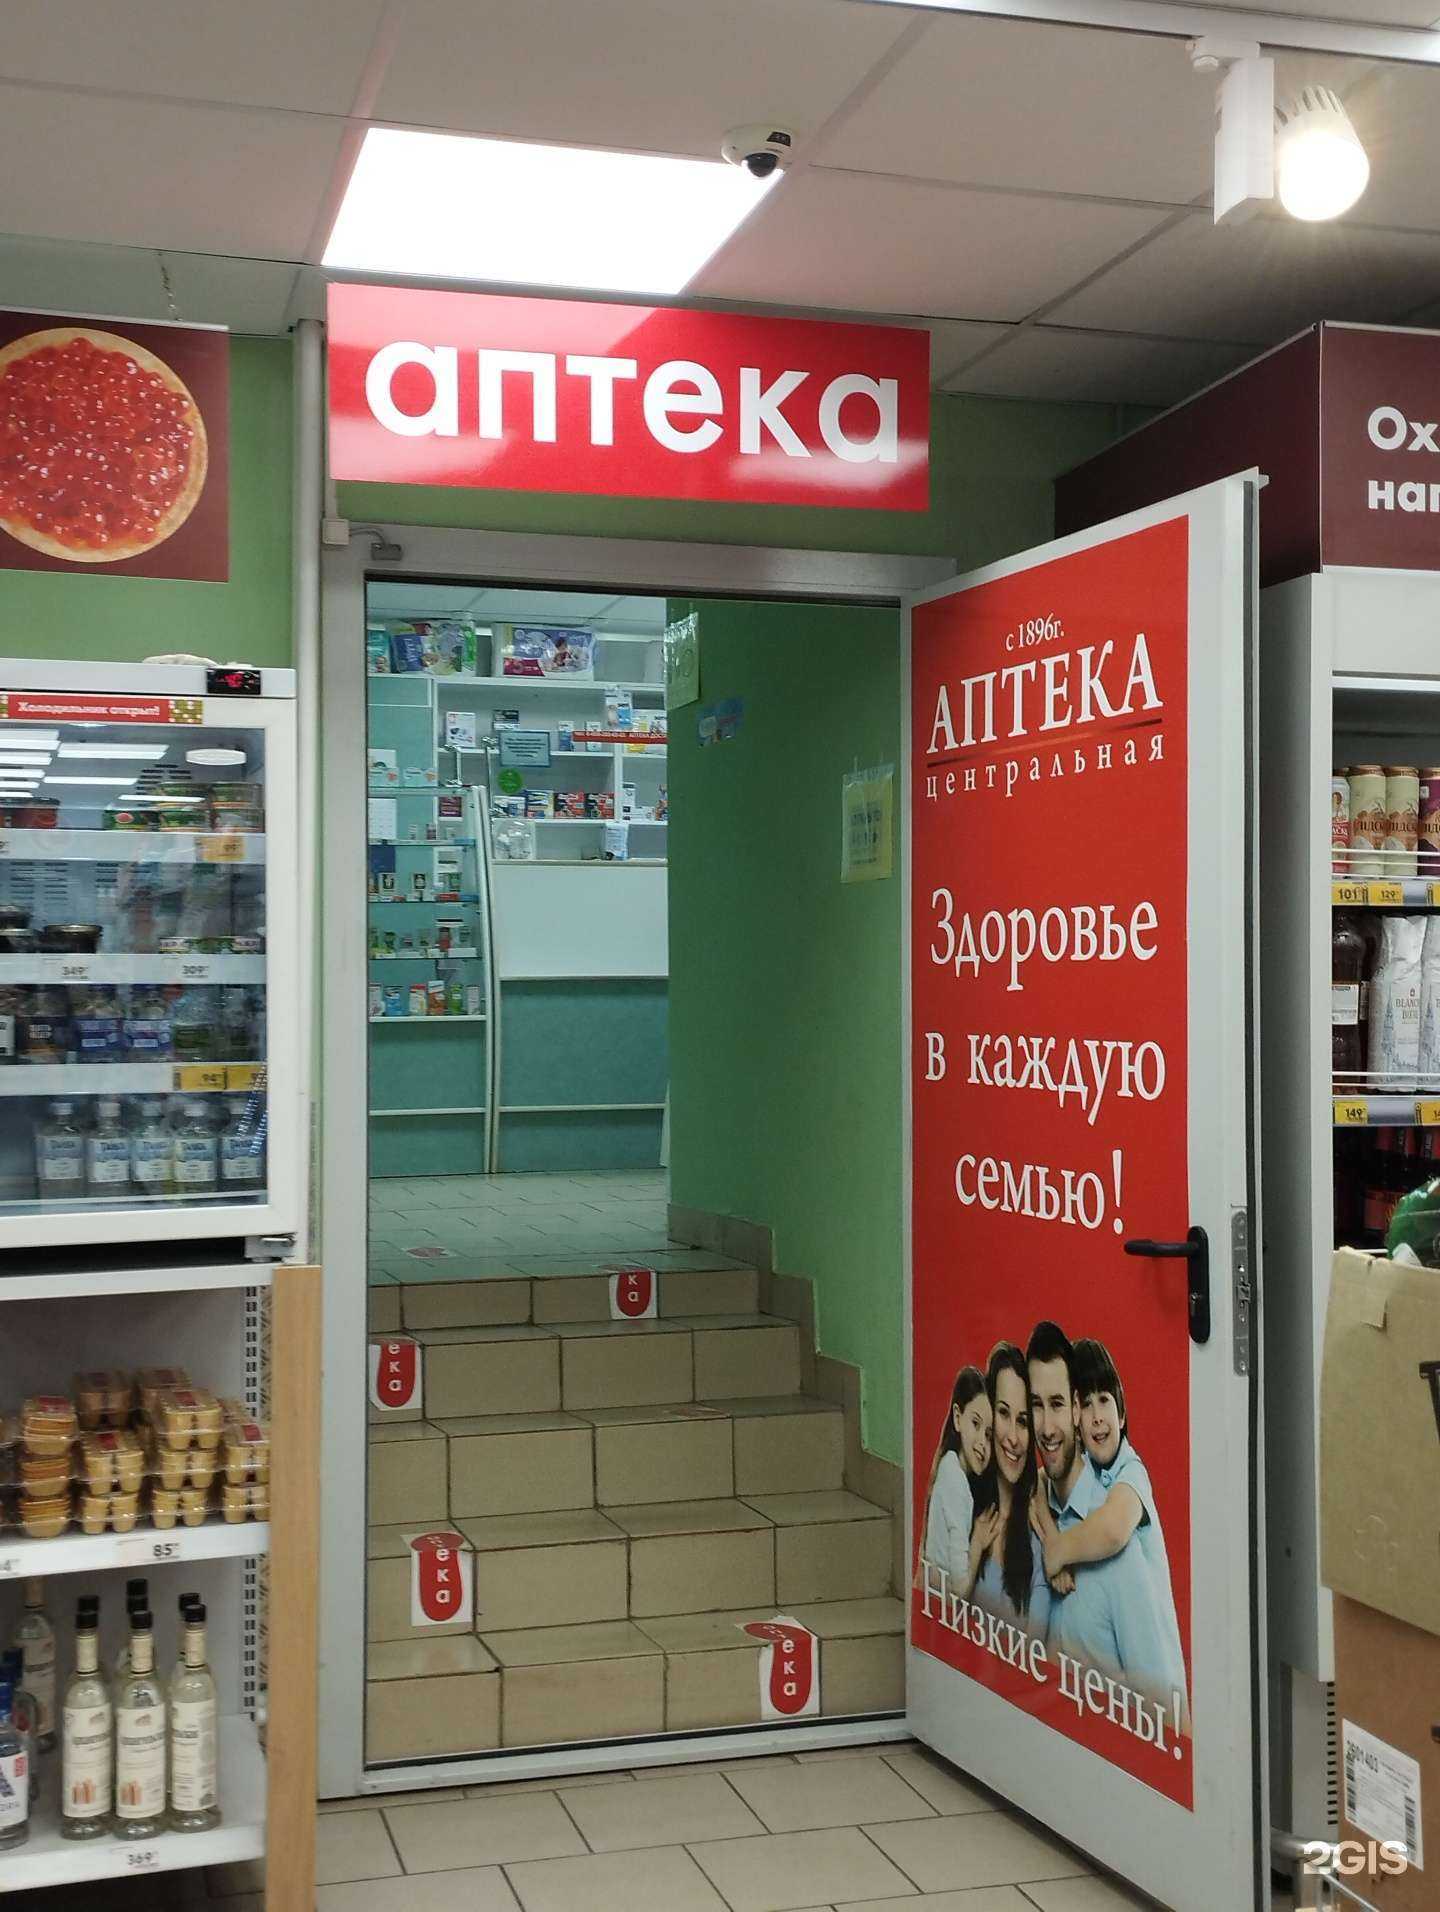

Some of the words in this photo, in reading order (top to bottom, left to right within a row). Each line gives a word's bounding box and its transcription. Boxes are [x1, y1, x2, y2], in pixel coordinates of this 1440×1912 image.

[365, 340, 899, 464] аптека
[1005, 632, 1014, 651] с
[1018, 612, 1065, 648] 1896г.
[926, 632, 1164, 754] АПТЕКА
[926, 733, 1164, 802] центральная
[931, 887, 1159, 991] Здоровье
[925, 1032, 946, 1081] в
[967, 1033, 1166, 1126] каждую
[955, 1149, 1124, 1235] семью!
[921, 1558, 1048, 1683] Низкие
[1057, 1651, 1182, 1760] цены!
